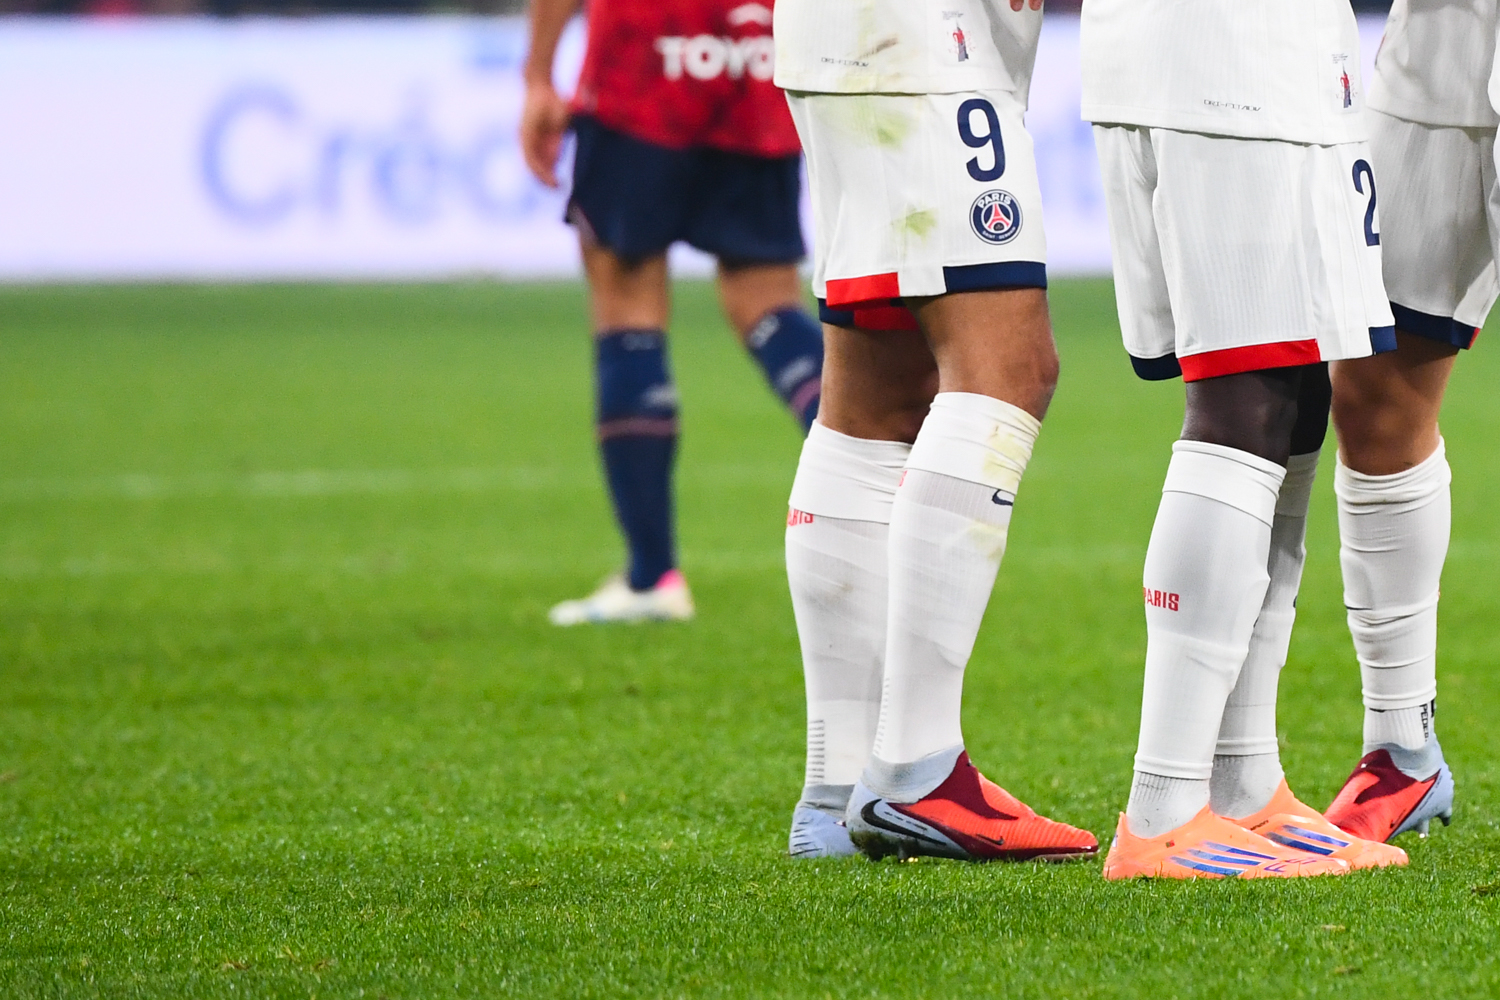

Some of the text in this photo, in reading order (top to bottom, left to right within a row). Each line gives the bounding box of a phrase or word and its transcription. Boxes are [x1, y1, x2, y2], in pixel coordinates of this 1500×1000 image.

[654, 34, 774, 81] TOYO
[957, 98, 1006, 182] 9
[977, 193, 1012, 208] PARIS
